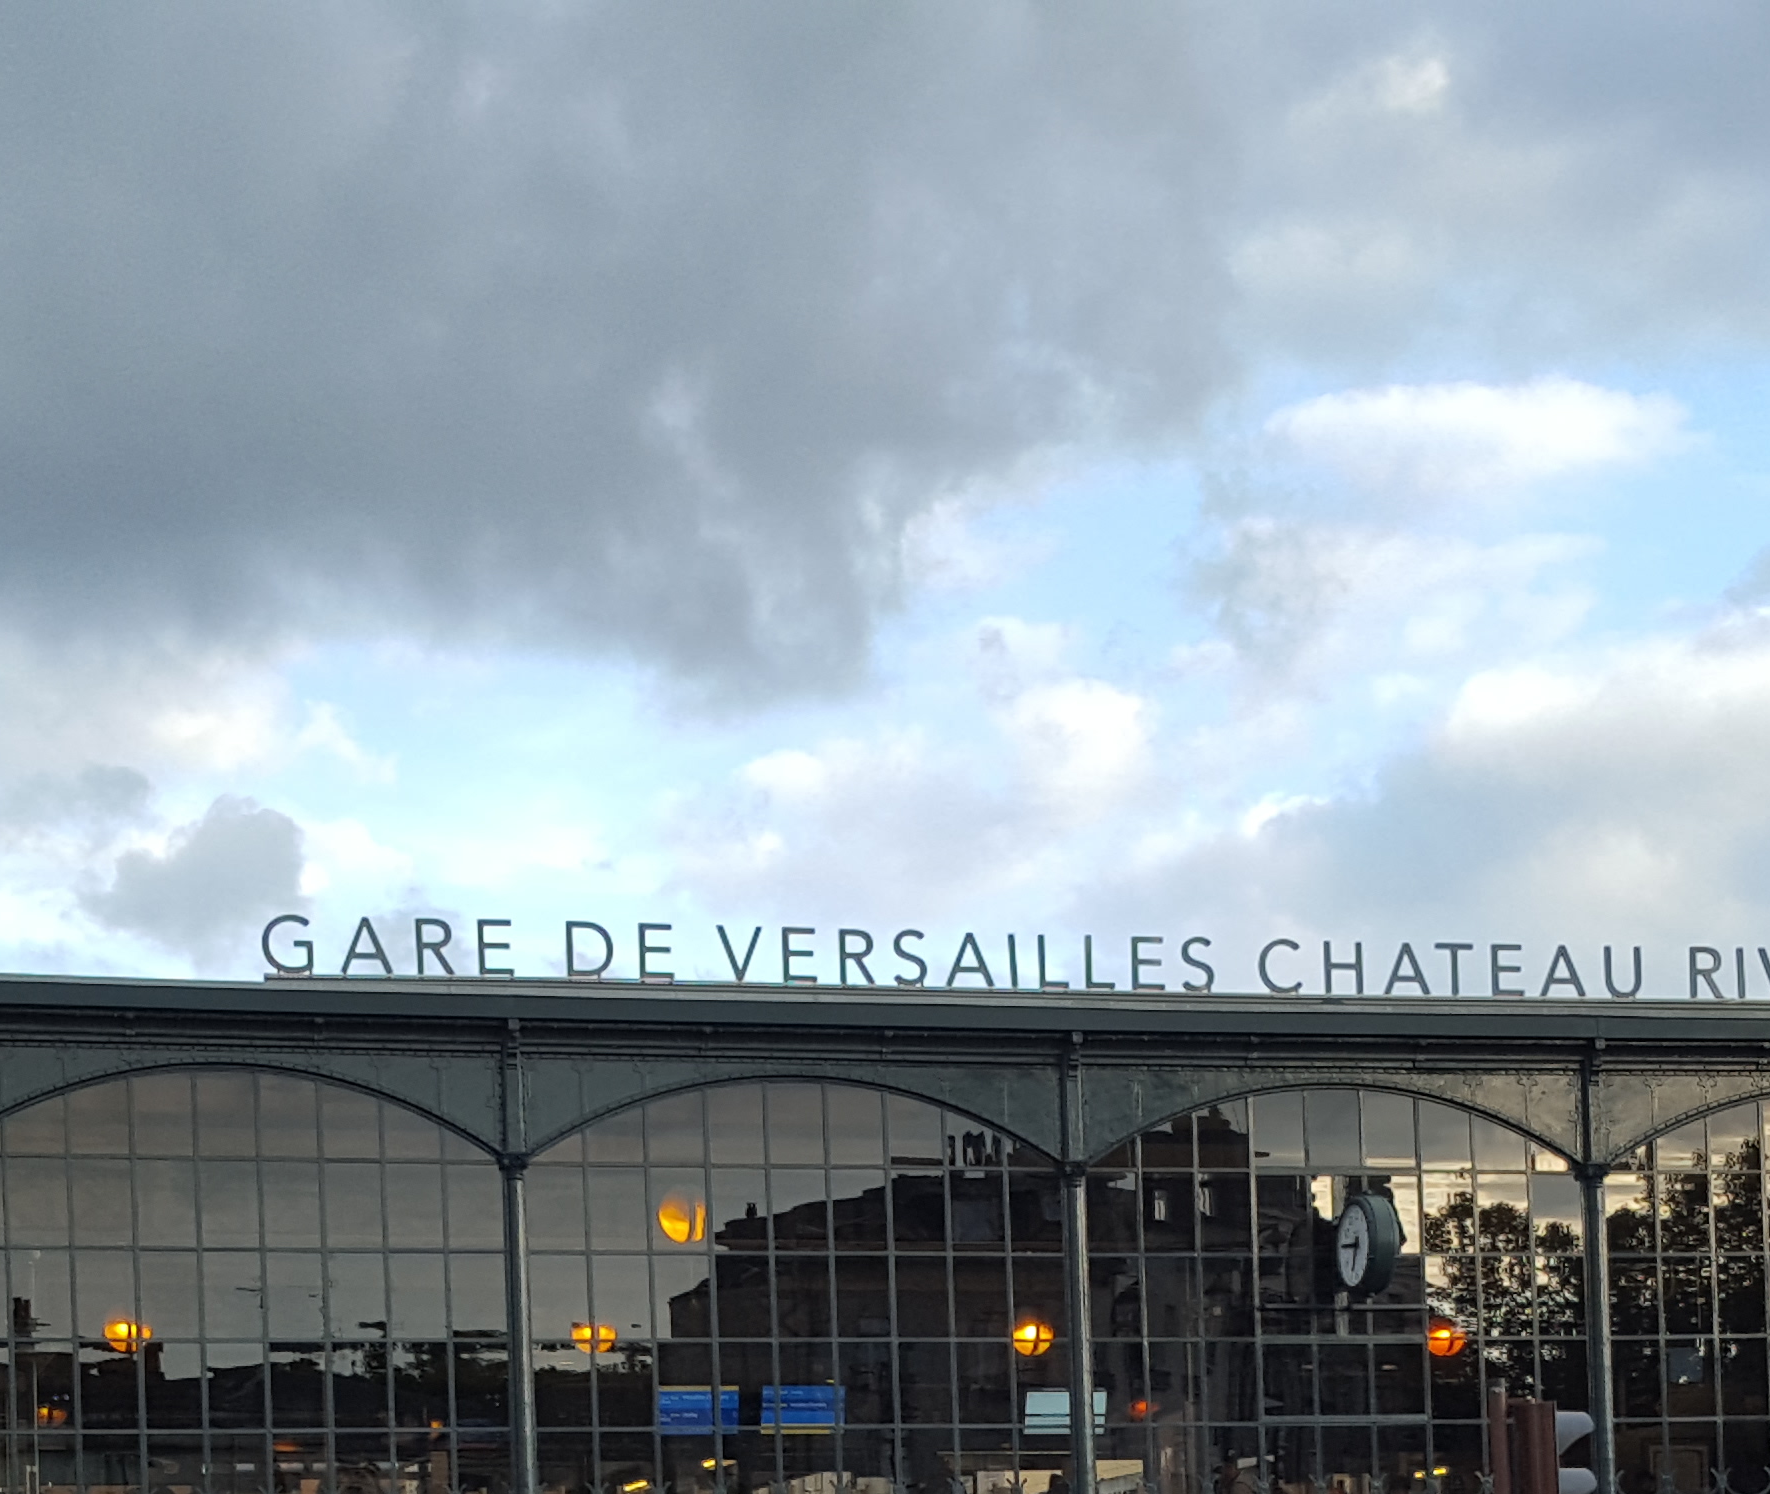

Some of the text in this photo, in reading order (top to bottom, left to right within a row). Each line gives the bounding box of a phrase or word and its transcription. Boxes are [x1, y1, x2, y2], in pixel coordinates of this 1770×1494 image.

[261, 914, 515, 975] GARE
[565, 920, 675, 980] DE
[716, 924, 1215, 992] VERSAILLES
[1258, 938, 1643, 998] CHATEAU
